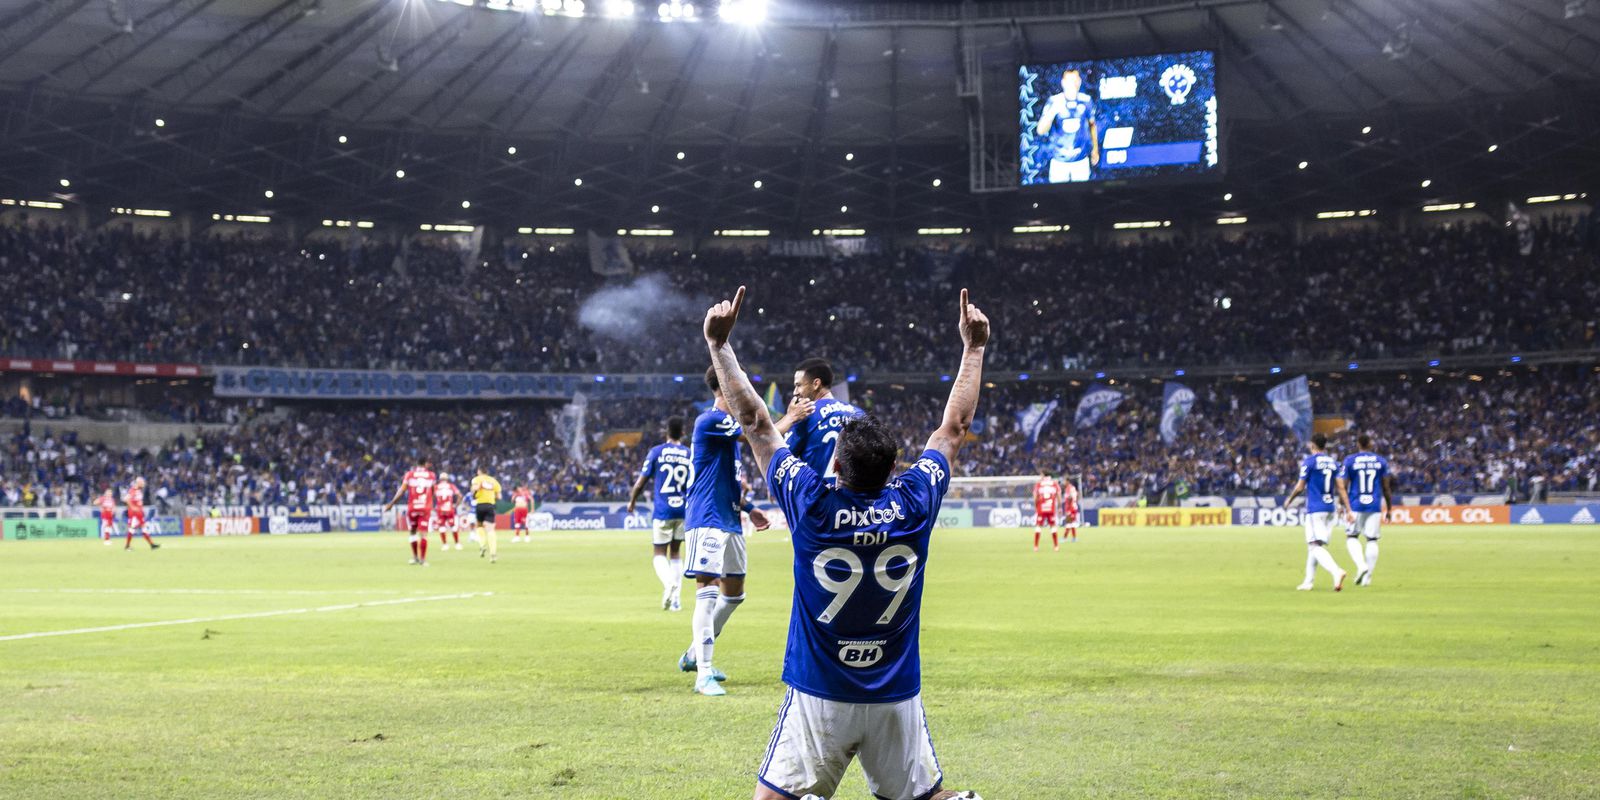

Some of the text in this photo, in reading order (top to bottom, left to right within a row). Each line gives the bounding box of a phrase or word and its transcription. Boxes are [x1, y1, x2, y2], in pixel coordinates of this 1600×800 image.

[246, 369, 417, 396] CRUZEIRO
[426, 373, 583, 397] ESPORTE
[659, 463, 688, 493] 29
[1322, 468, 1333, 493] 7
[1358, 468, 1377, 493] 17
[204, 517, 253, 536] BETANO
[553, 516, 606, 530] nacional
[834, 501, 906, 529] pixbet
[1421, 508, 1454, 523] GOL
[1462, 508, 1494, 523] GOL
[853, 531, 888, 546] EDU
[812, 544, 918, 624] 99
[844, 647, 878, 662] BH
